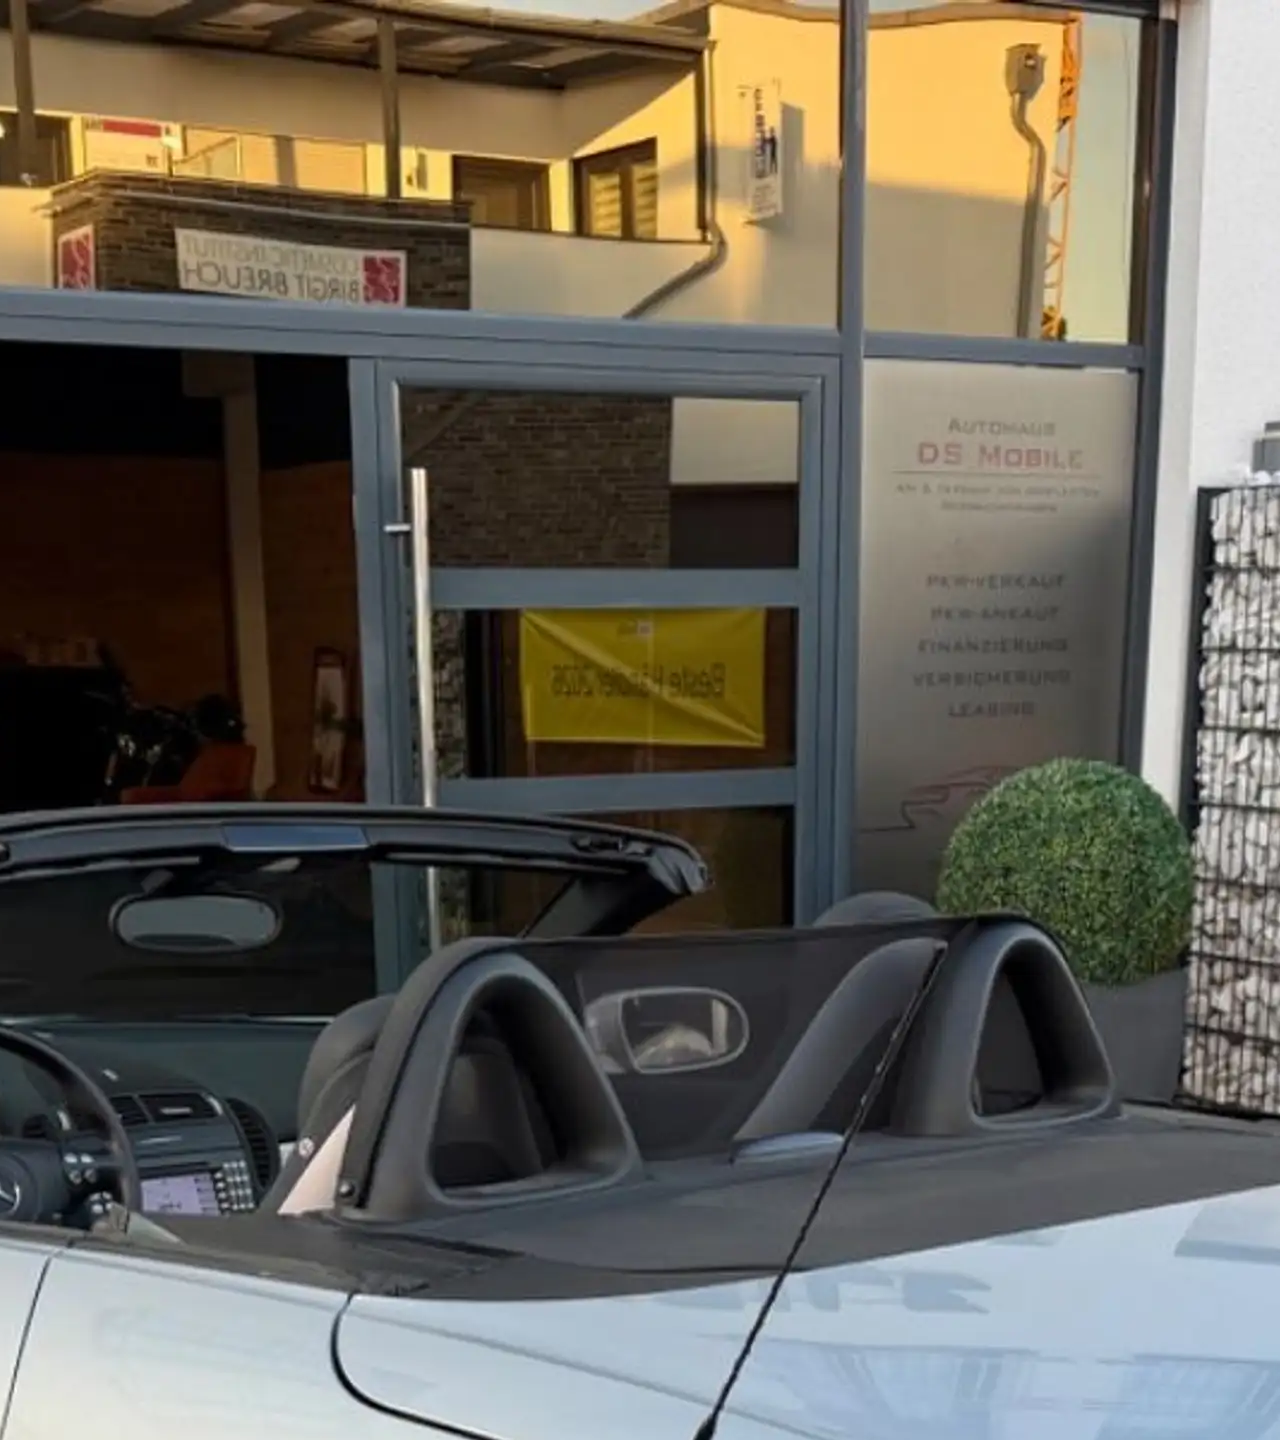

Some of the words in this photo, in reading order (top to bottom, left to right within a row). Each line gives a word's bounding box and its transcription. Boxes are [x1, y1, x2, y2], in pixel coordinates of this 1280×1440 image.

[948, 417, 1056, 436] AUTOHAUS
[917, 442, 963, 466] DS
[977, 444, 1083, 470] MOBILE
